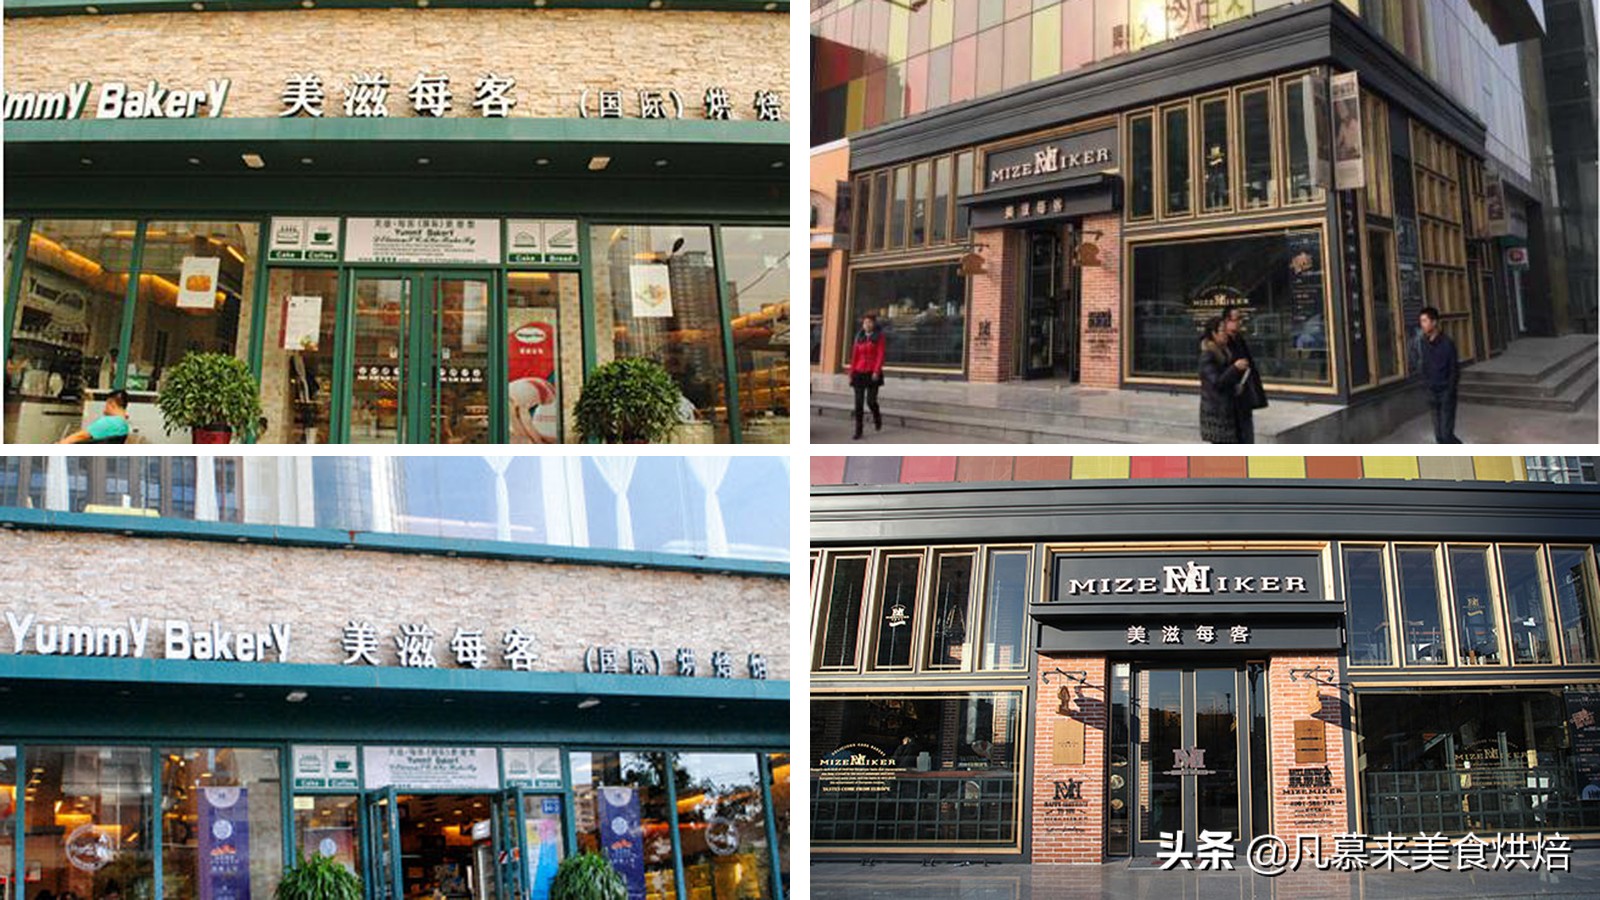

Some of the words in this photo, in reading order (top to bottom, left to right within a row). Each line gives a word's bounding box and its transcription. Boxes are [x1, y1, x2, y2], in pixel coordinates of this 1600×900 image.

[3, 81, 87, 120] mmy
[1127, 625, 1250, 644] 美滋每客
